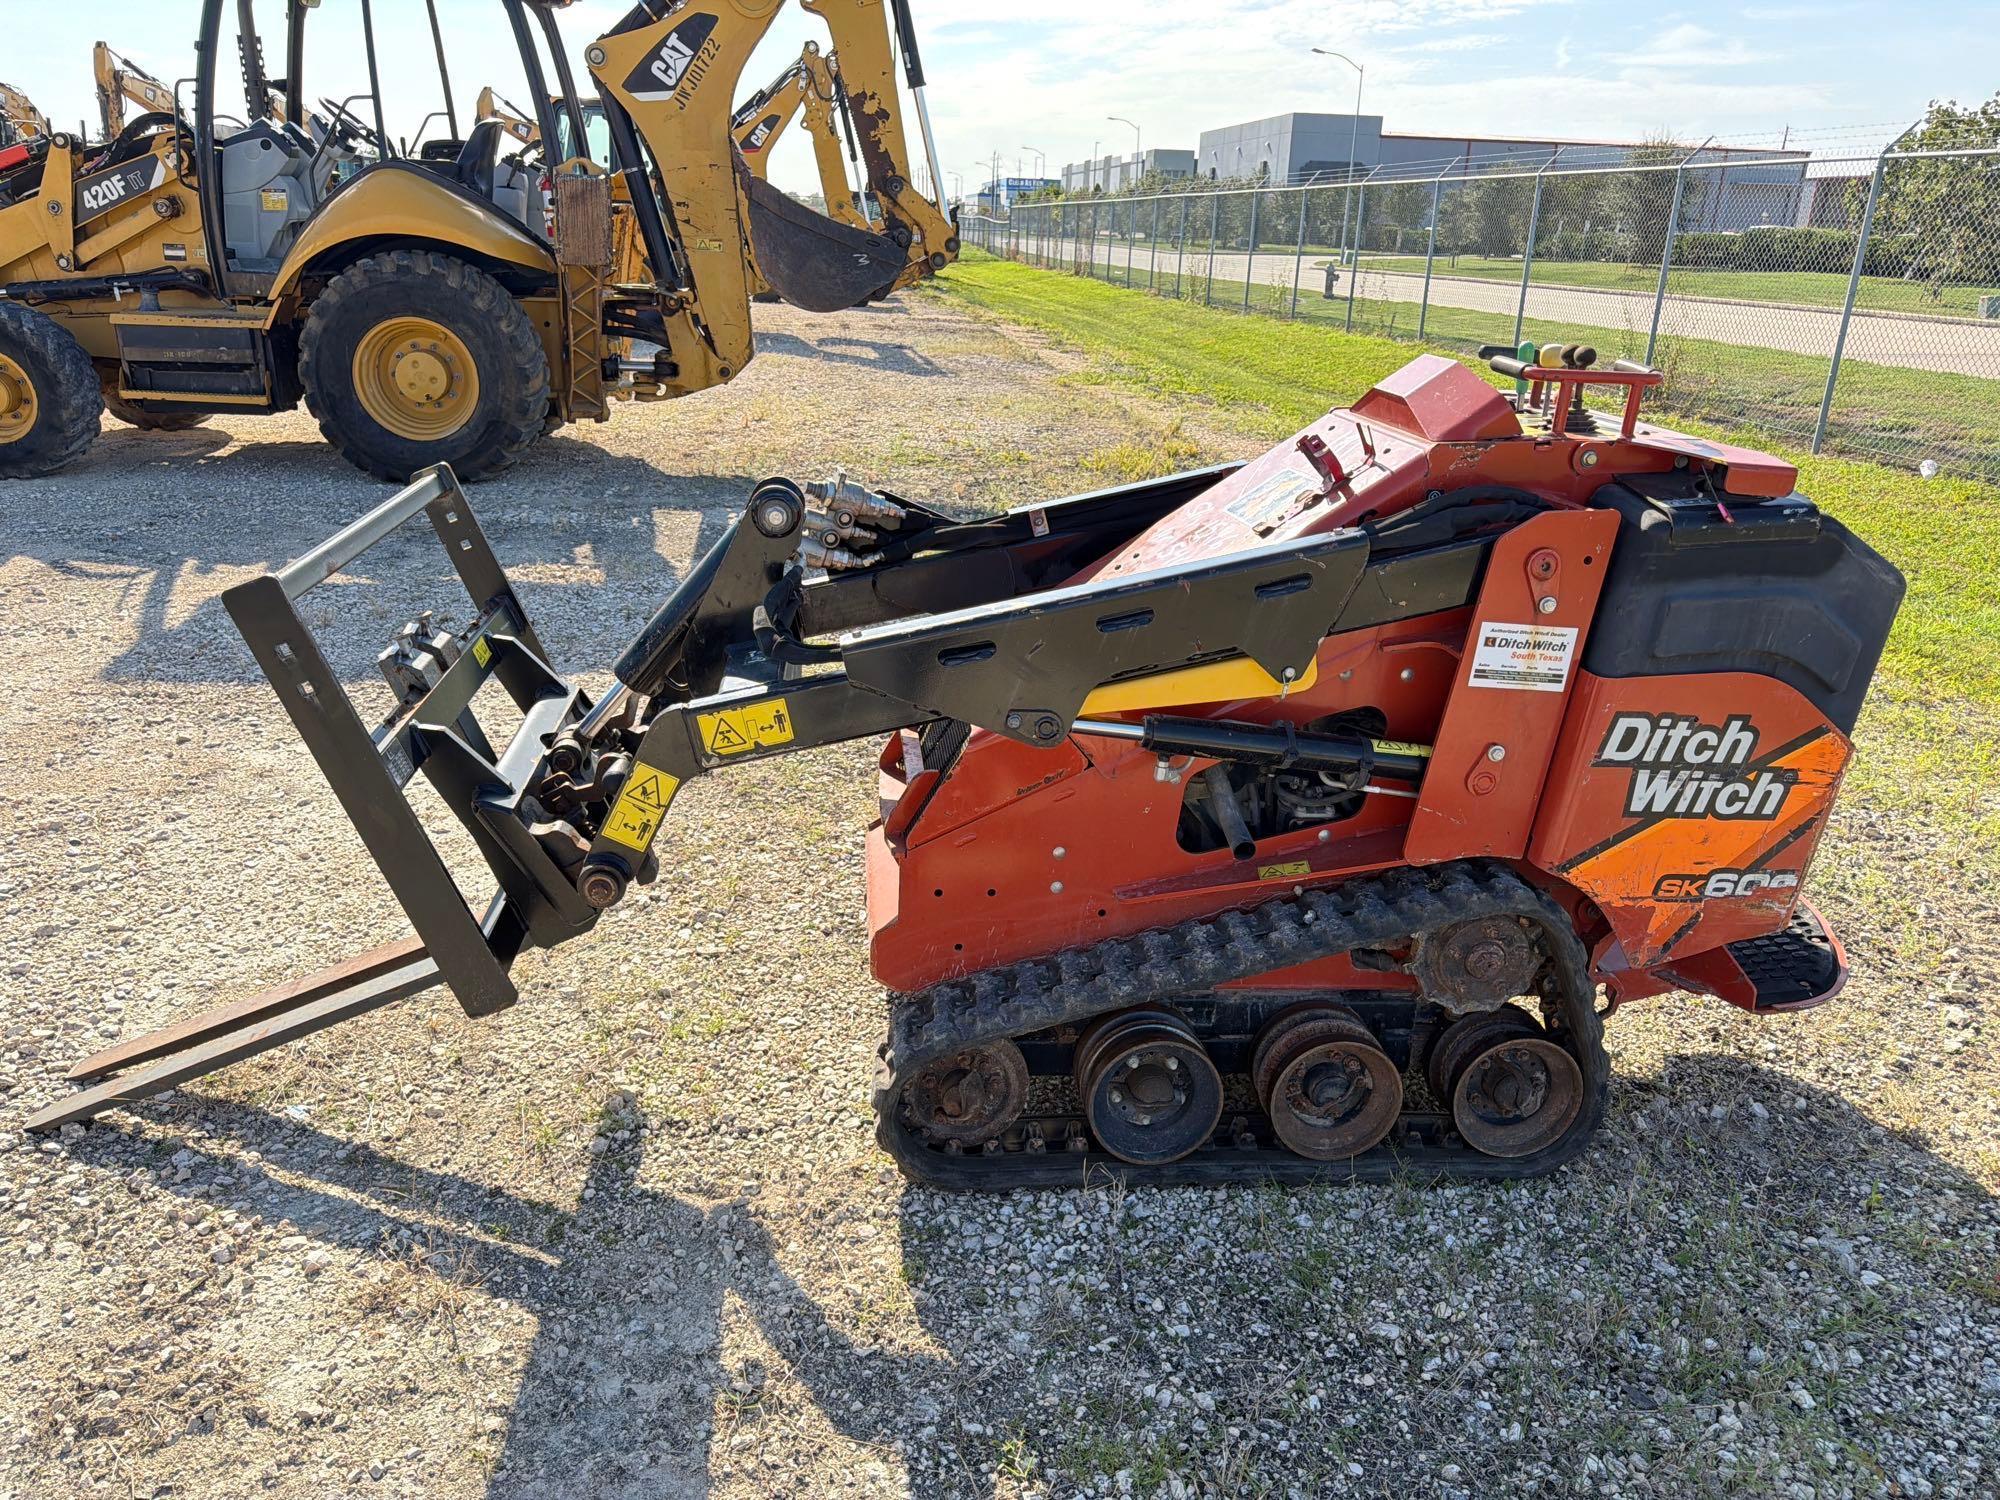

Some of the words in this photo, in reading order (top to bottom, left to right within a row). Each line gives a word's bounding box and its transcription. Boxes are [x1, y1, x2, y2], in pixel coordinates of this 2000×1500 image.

[651, 32, 694, 86] CAT
[750, 122, 771, 147] CAT
[83, 173, 126, 210] 420F
[1510, 651, 1536, 660] South
[1539, 653, 1563, 662] Texas
[1601, 717, 1753, 763] Ditch
[1629, 769, 1784, 815] Witch
